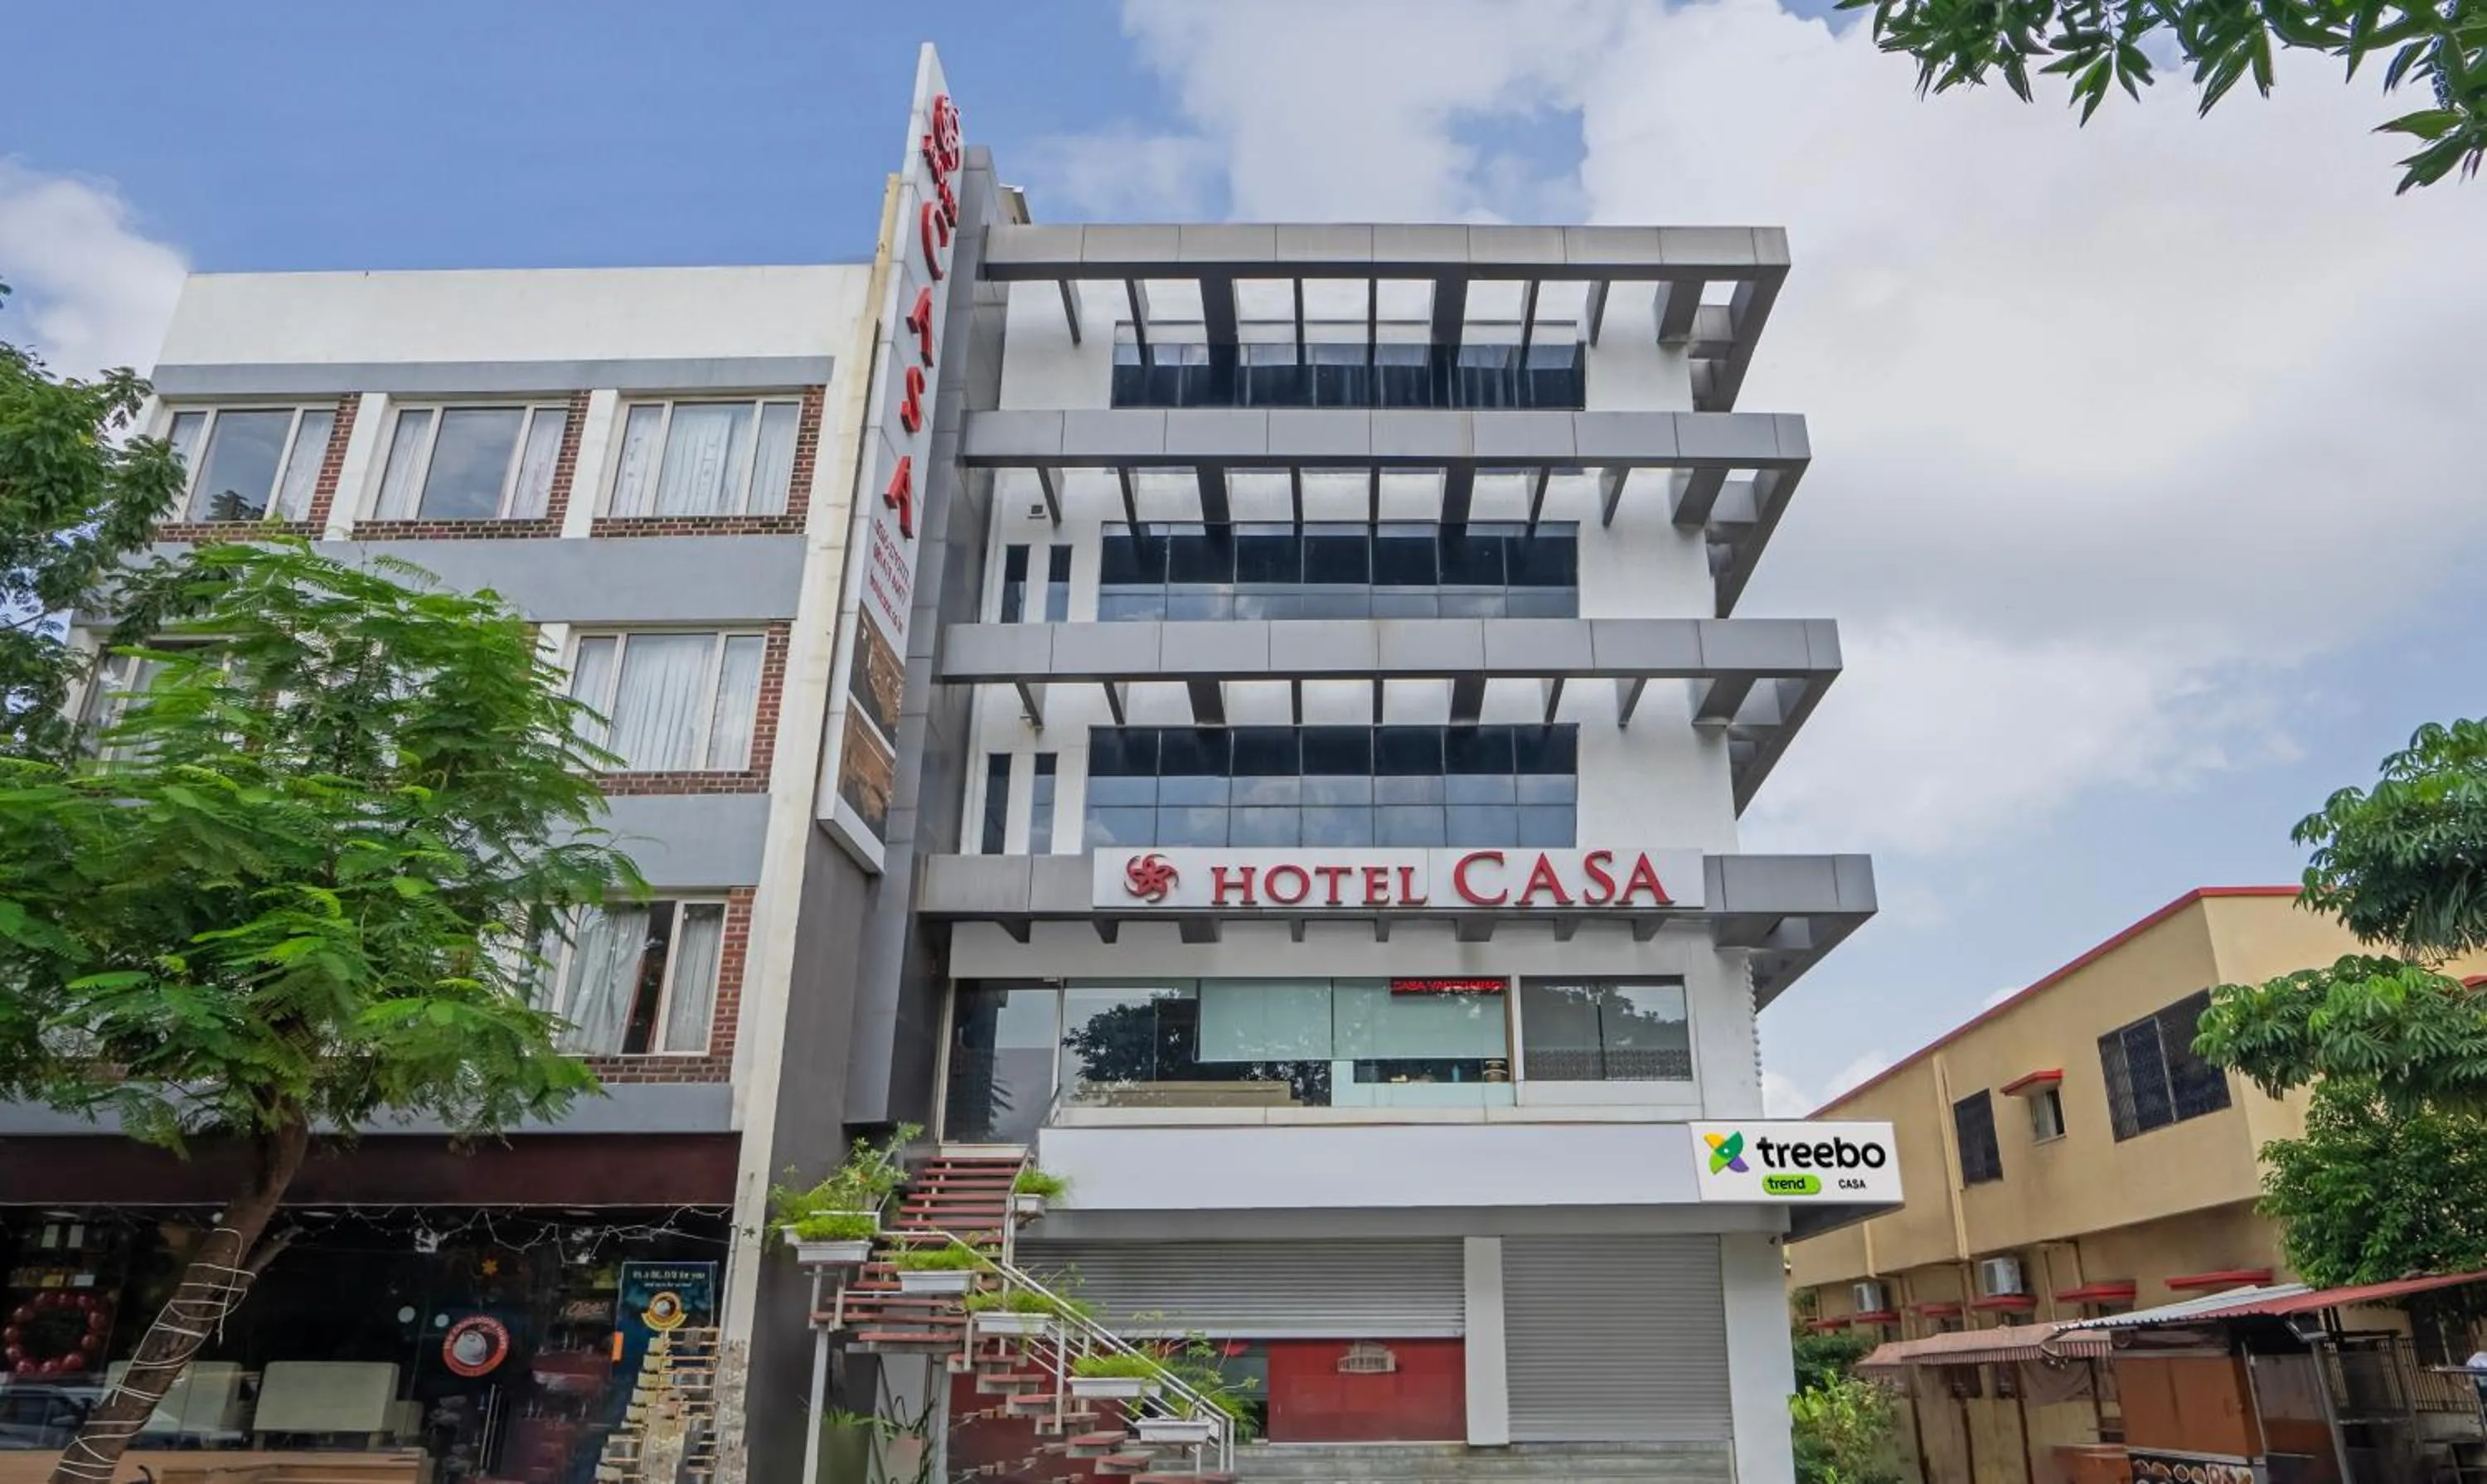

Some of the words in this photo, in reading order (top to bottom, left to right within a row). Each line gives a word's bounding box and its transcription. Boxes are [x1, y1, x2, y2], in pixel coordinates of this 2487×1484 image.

[884, 201, 949, 539] CASA
[1210, 864, 1428, 905] HOTEL
[1453, 851, 1676, 905] CASA
[1756, 1137, 1886, 1169] treebo
[1767, 1177, 1806, 1190] trend
[1838, 1179, 1867, 1190] CASA
